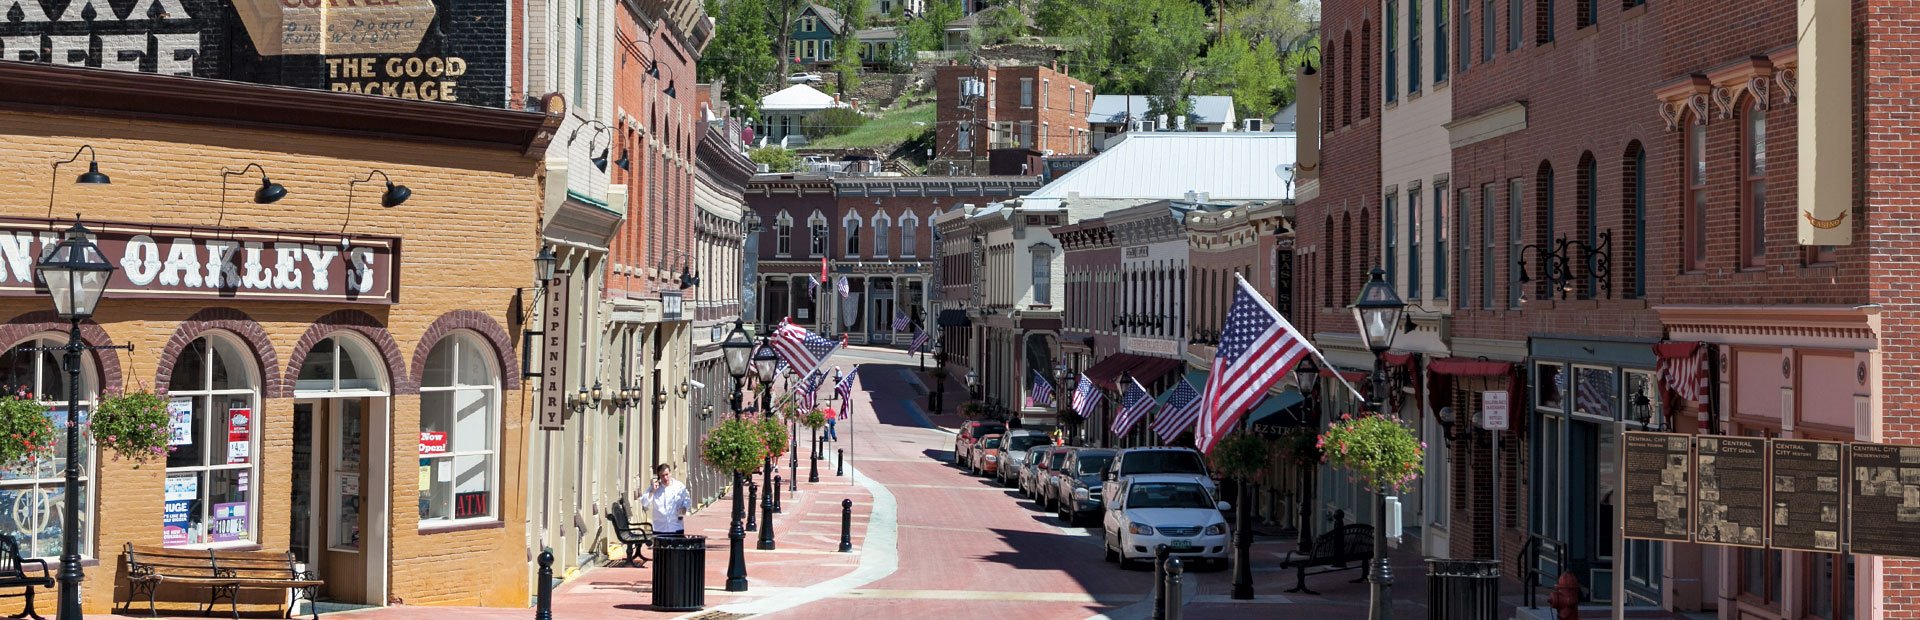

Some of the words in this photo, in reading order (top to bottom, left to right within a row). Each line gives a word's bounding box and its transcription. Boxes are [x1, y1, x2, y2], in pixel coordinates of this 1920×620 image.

[287, 22, 335, 32] One
[352, 19, 415, 31] Pound
[283, 33, 322, 45] Full
[331, 31, 400, 44] Weight
[326, 57, 377, 78] THE
[385, 57, 467, 78] GOOD
[1811, 220, 1840, 228] CASINO
[120, 235, 374, 293] OAKLEY'S
[1280, 253, 1291, 288] EASY
[547, 277, 562, 423] DISPENSARY
[1255, 423, 1269, 433] EZ
[421, 432, 443, 441] Now
[419, 444, 445, 452] Open!
[456, 494, 487, 516] ATM
